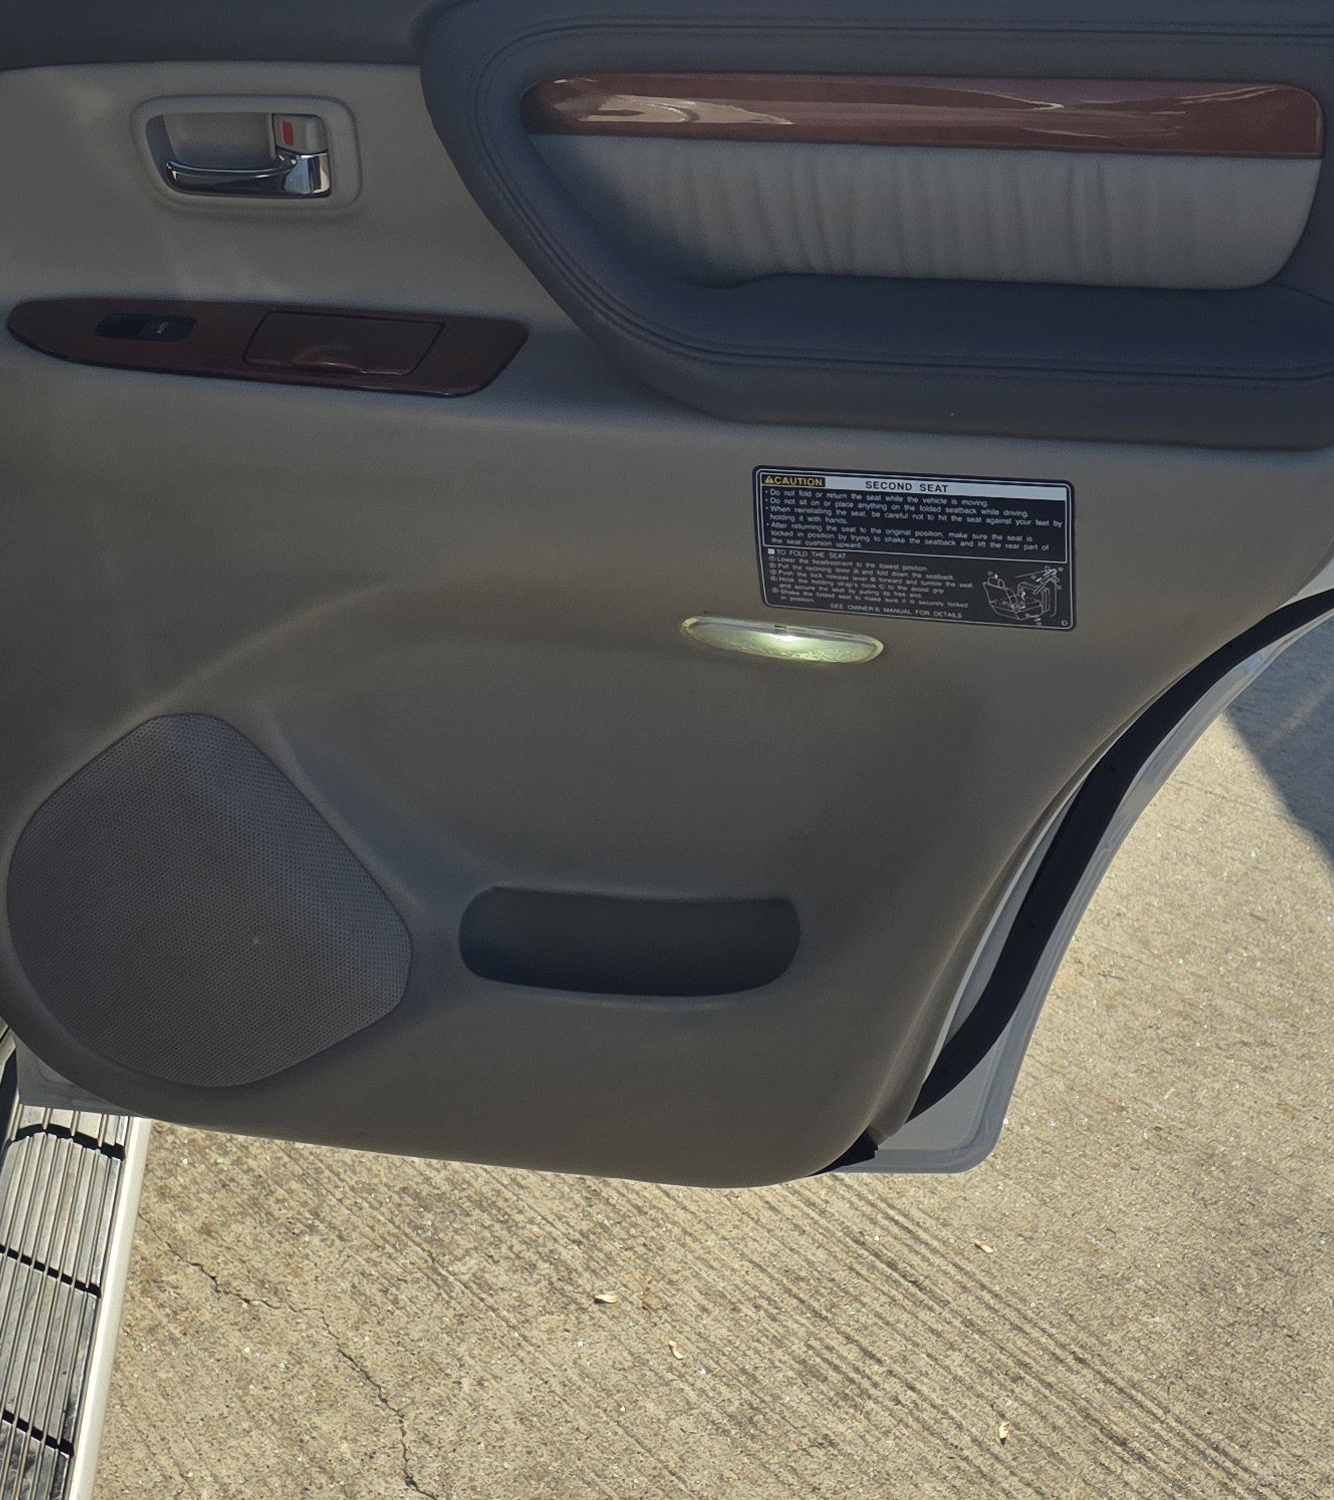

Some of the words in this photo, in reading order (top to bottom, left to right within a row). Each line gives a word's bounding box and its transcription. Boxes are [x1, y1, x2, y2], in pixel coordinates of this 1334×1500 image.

[773, 476, 823, 486] CAUTION
[865, 481, 912, 491] SECOND
[919, 484, 949, 493] SEAT
[798, 489, 812, 497] fold
[826, 491, 847, 499] return
[922, 495, 947, 504] vehicle
[783, 497, 796, 505] not
[799, 498, 807, 506] sit
[834, 500, 854, 509] place
[857, 501, 888, 511] anything
[903, 503, 915, 511] the
[919, 504, 942, 513] folded
[945, 505, 977, 514] seatback
[980, 507, 1000, 516] while
[769, 513, 796, 522] holding
[807, 515, 822, 523] with
[770, 504, 791, 513] When
[835, 508, 847, 516] the
[884, 510, 909, 519] careful
[911, 512, 924, 520] not
[938, 513, 947, 521] hit
[950, 514, 962, 522] the
[966, 515, 982, 523] seat
[985, 516, 1012, 526] against
[1015, 518, 1031, 527] your
[1035, 518, 1049, 527] feet
[790, 522, 822, 532] returning
[885, 528, 912, 537] original
[948, 531, 968, 539] make
[1006, 534, 1023, 542] seat
[770, 529, 794, 537] locked
[807, 531, 835, 541] position
[850, 533, 870, 543] trying
[884, 535, 905, 544] shake
[909, 537, 921, 545] the
[924, 538, 956, 547] seatback
[960, 540, 974, 548] and
[977, 541, 986, 549] lift
[1023, 544, 1038, 553] part
[788, 549, 808, 557] FOLD
[811, 550, 825, 558] THE
[828, 551, 846, 559] SEAT
[846, 603, 880, 612] OWNER'S
[882, 606, 912, 614] MANUAL
[933, 610, 962, 618] DETAILS
